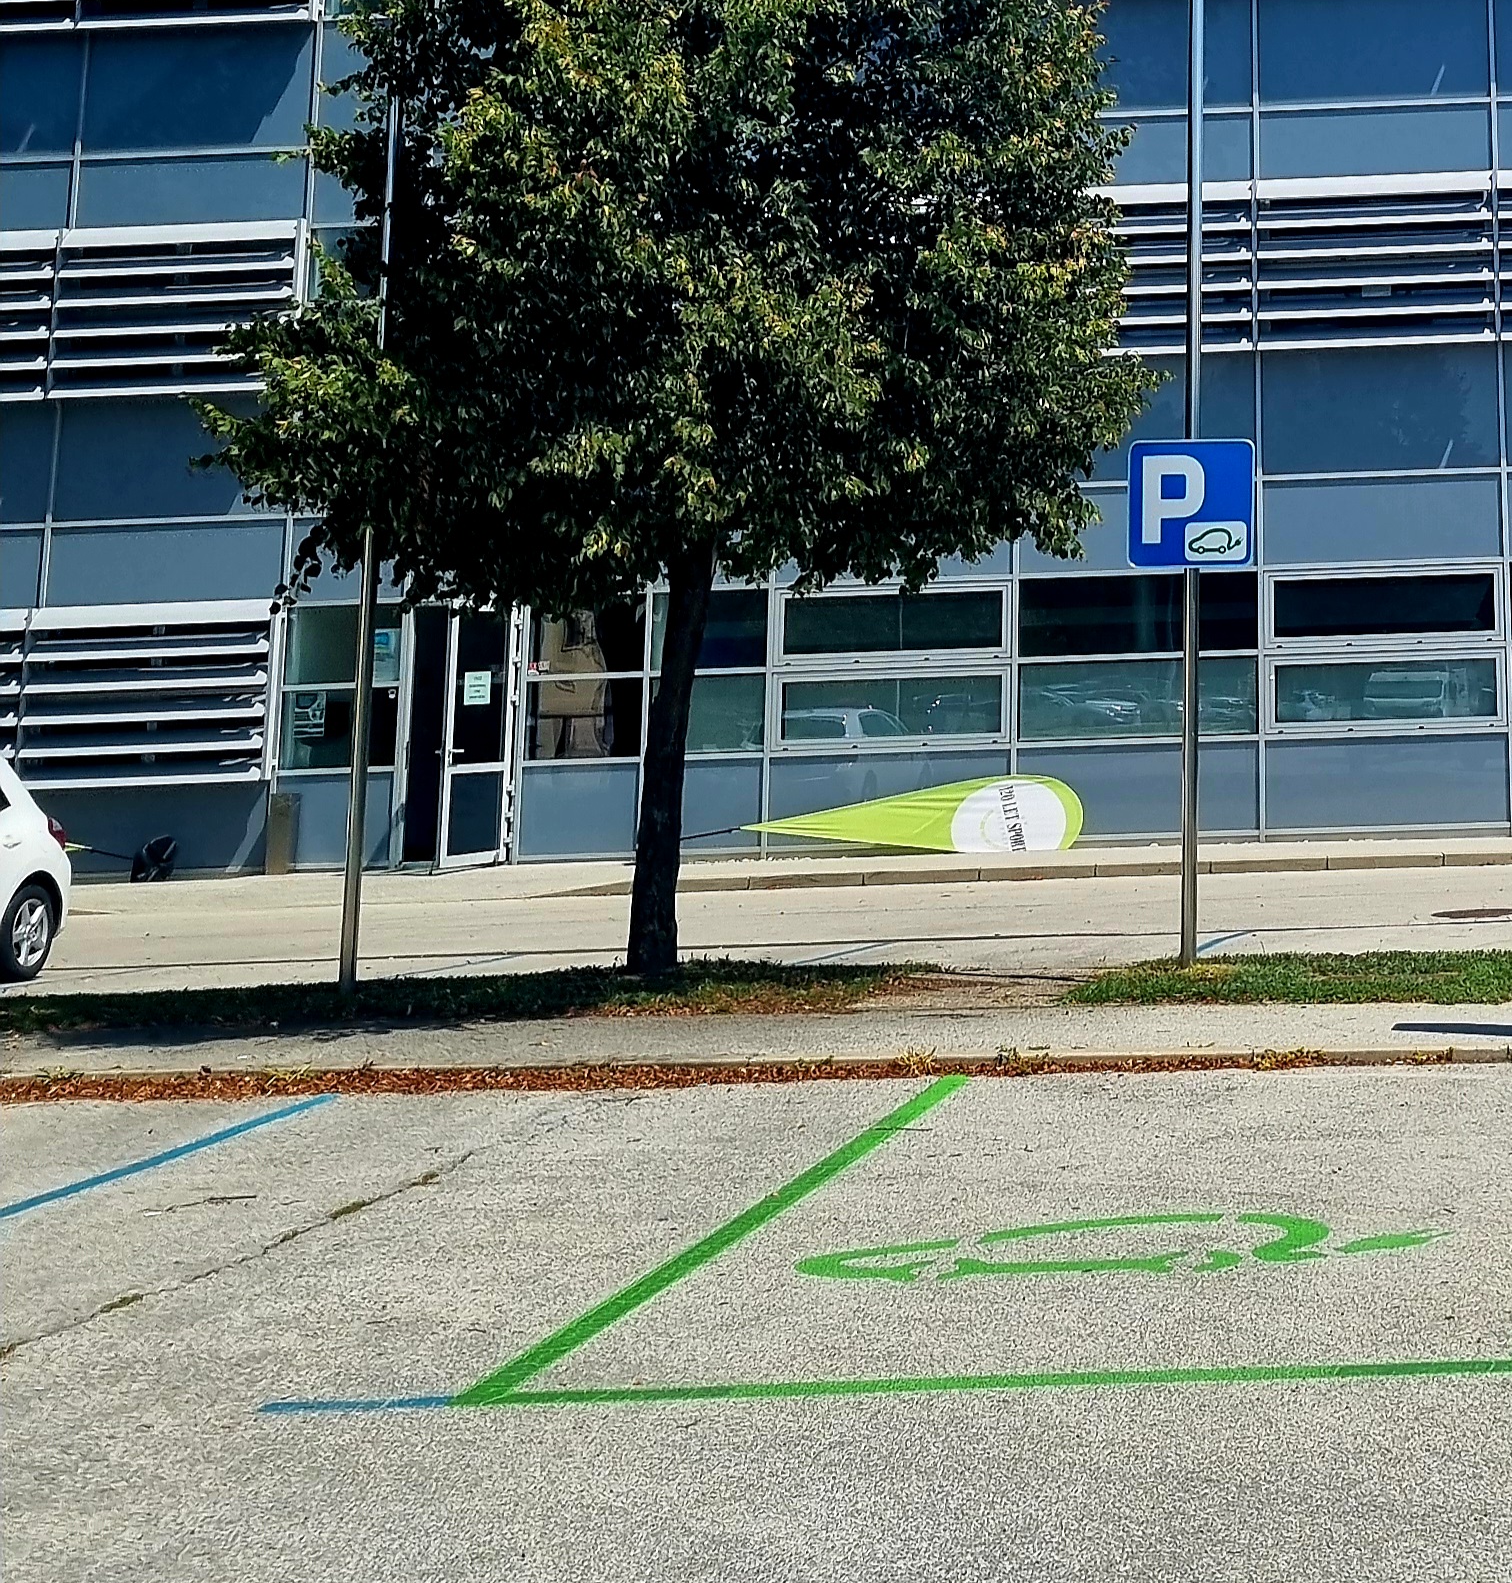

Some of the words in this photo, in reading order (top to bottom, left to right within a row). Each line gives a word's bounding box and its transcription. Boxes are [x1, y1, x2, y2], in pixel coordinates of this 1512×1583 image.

[1141, 454, 1205, 544] P
[999, 785, 1015, 801] 120
[1002, 802, 1020, 820] LET
